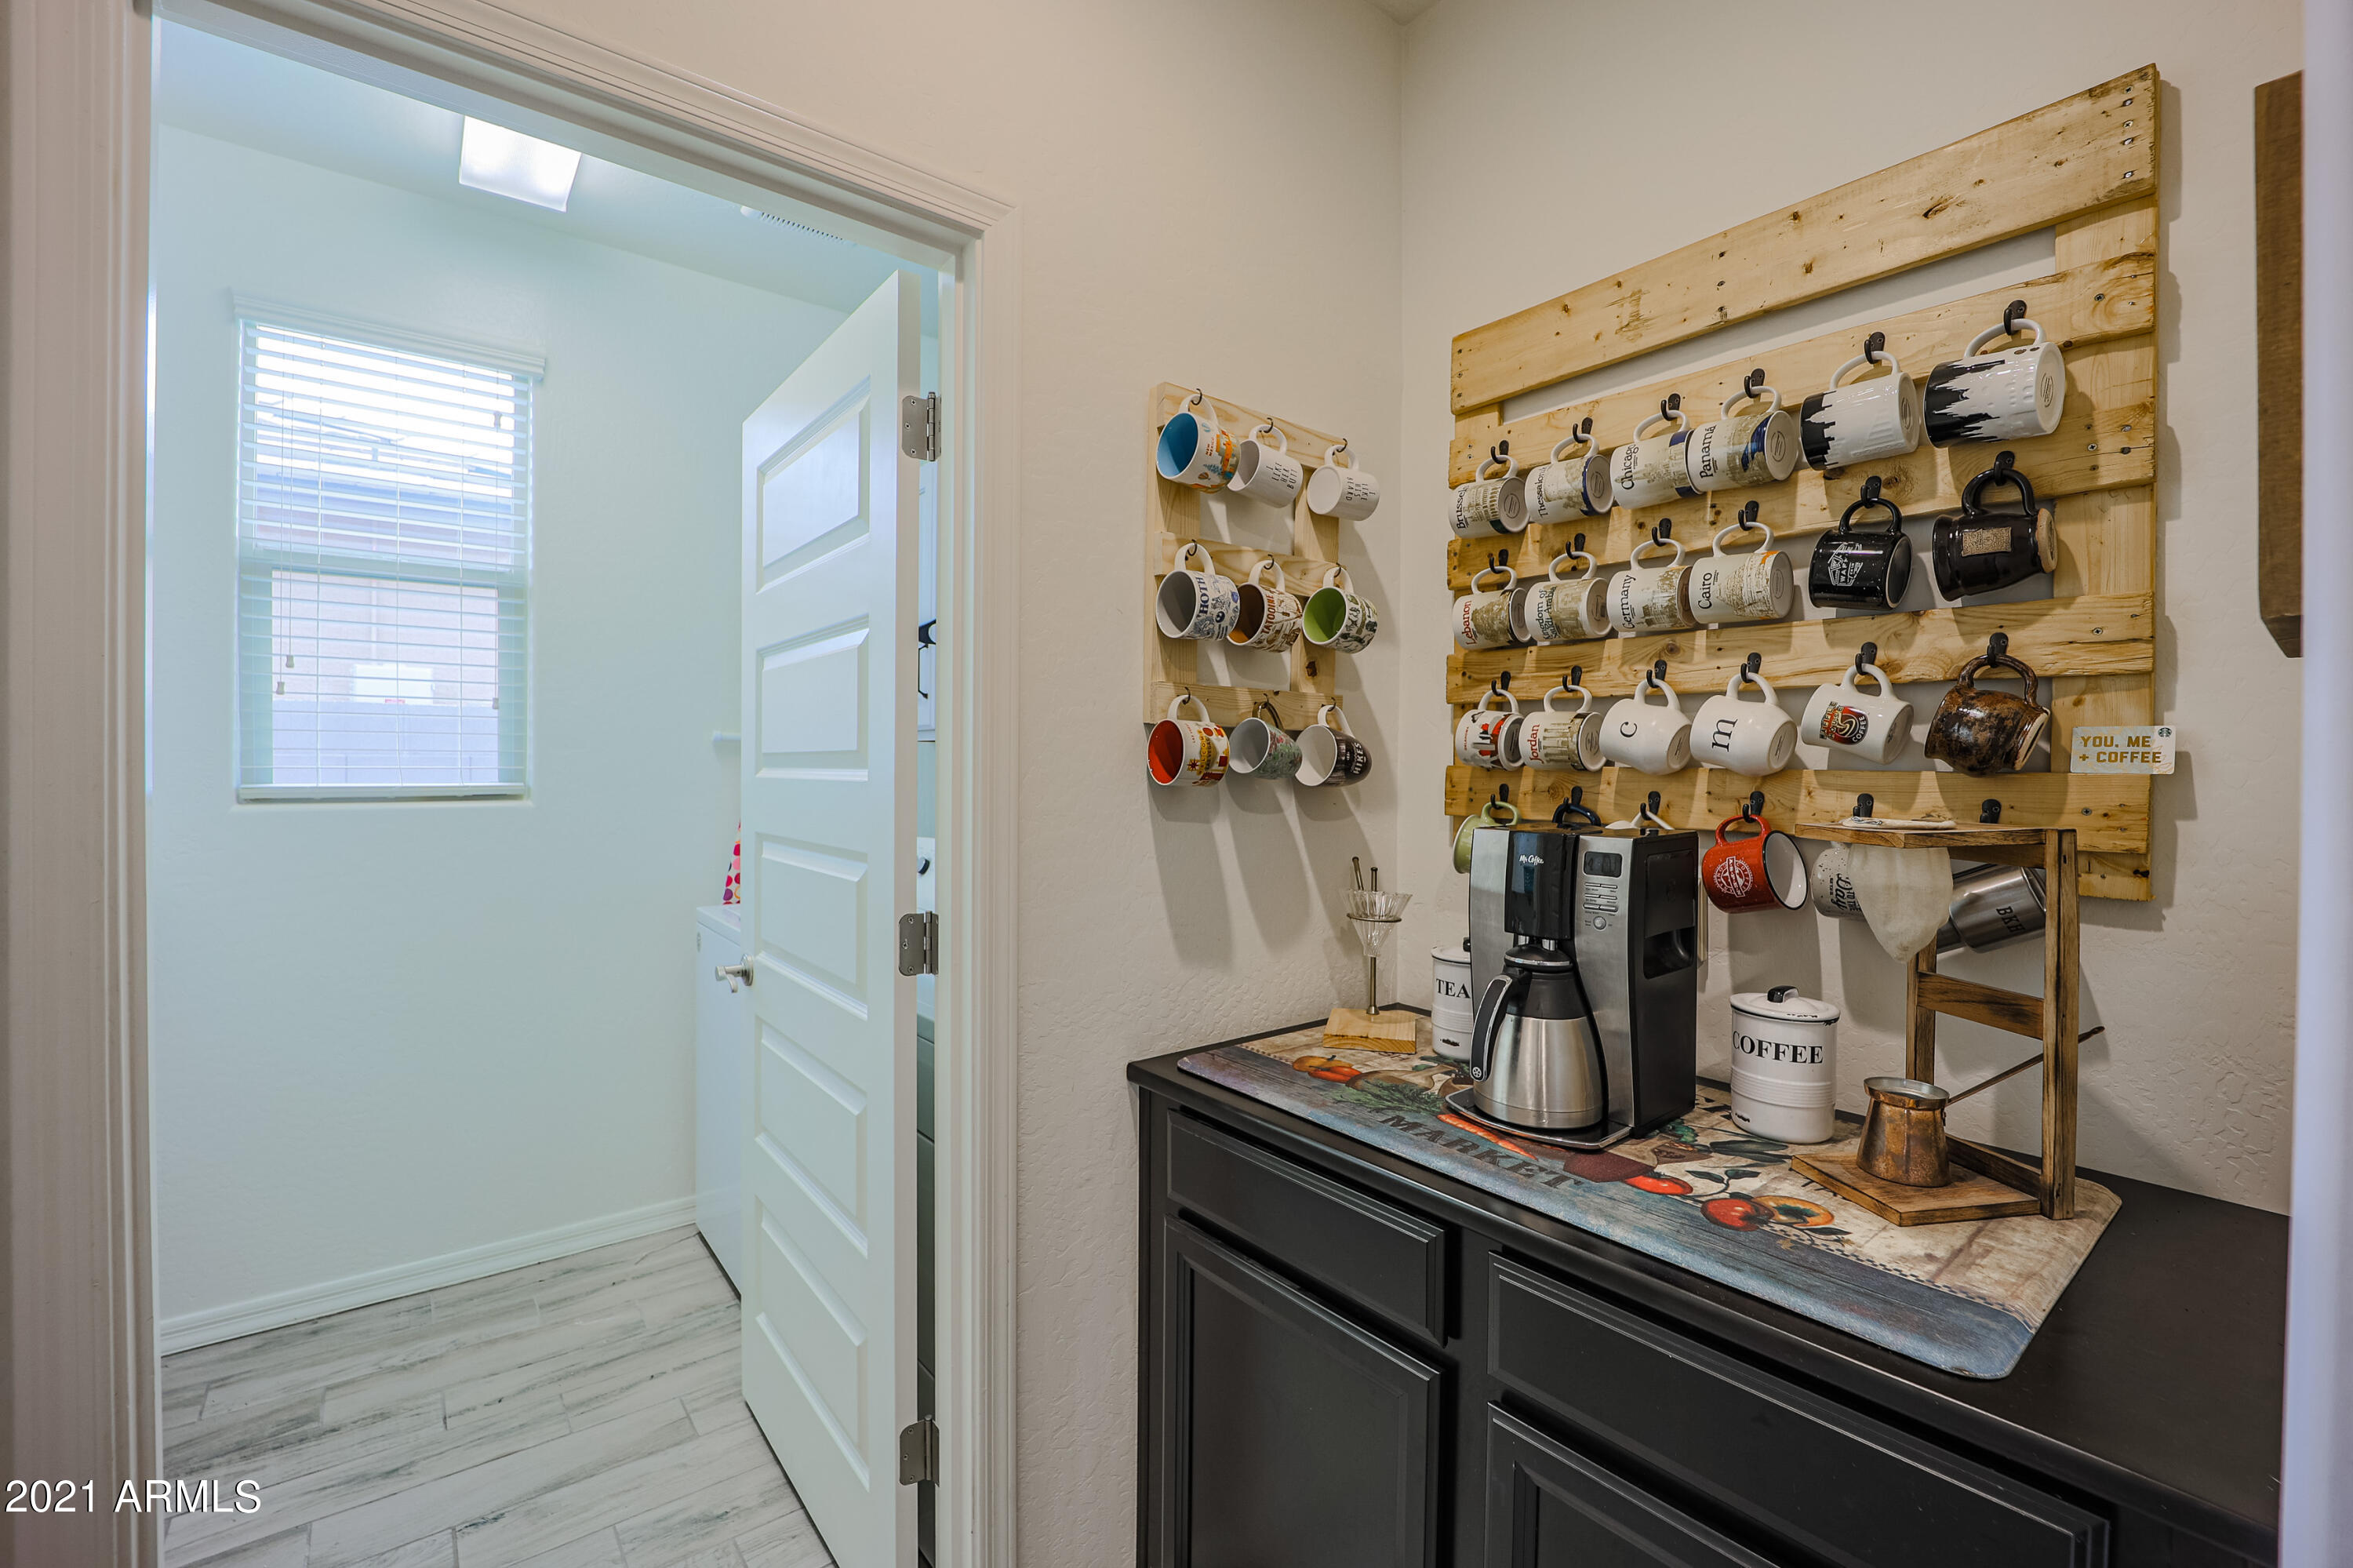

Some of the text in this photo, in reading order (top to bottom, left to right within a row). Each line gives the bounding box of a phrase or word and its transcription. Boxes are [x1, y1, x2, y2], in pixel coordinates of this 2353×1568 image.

[1620, 443, 1639, 490] Chicago
[1197, 577, 1209, 615] HOTH
[1622, 574, 1637, 629] Germany
[1698, 571, 1712, 610] Cairo
[1260, 595, 1277, 635] TATOOINE
[1463, 600, 1476, 646] Lebanon
[1536, 589, 1553, 639] Kingdom of
[1529, 723, 1544, 764] Jordan
[1711, 717, 1738, 753] m
[1852, 715, 1867, 742] COFFEE
[2126, 736, 2151, 748] ME
[1353, 742, 1363, 774] HIKES
[2096, 751, 2162, 763] COFFEE
[1831, 873, 1853, 911] Day
[1435, 978, 1471, 999] TEA
[1733, 1031, 1824, 1064] COFFEE
[1380, 1115, 1584, 1189] MARKET
